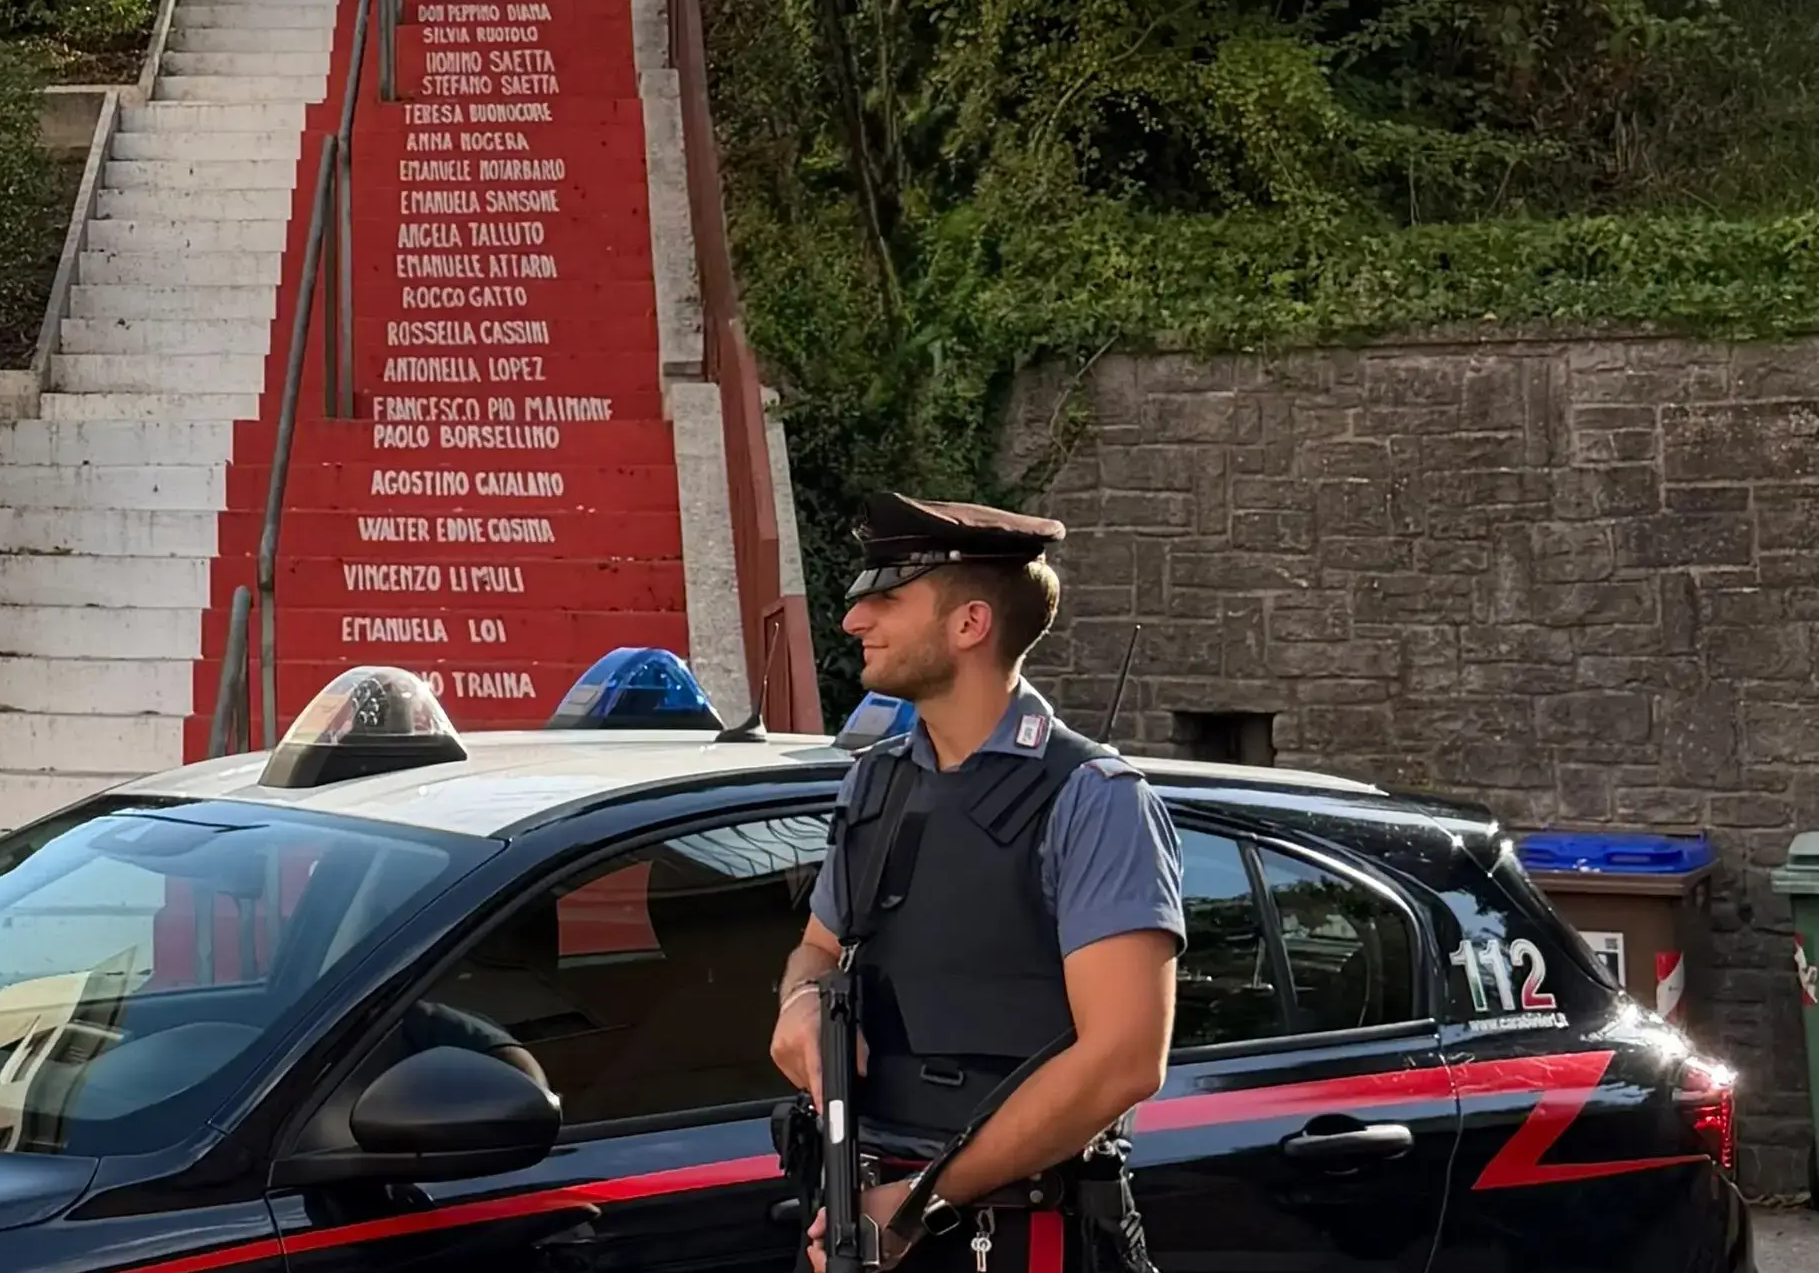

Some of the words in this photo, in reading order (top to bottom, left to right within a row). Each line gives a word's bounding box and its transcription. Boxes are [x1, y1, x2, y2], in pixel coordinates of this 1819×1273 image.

[418, 4, 445, 23] DON
[447, 4, 500, 22] PEPPINO
[507, 3, 552, 22] DIANA
[423, 27, 470, 44] SILVIA
[477, 26, 539, 44] RUOTOLO
[490, 49, 556, 73] SAETTA
[422, 75, 492, 97] STEFANO
[501, 75, 560, 96] SAETTA
[404, 104, 464, 125] TERESA
[406, 133, 453, 152] ANNA
[399, 160, 472, 182] EMANUELE
[400, 190, 481, 215] EMANUELA
[485, 189, 561, 213] SANSONE
[468, 222, 545, 247] TALLUTO
[396, 254, 485, 278] EMANUELE
[489, 254, 558, 279] ATTARDI
[402, 286, 465, 309] ROCCO
[468, 286, 528, 308] GATTO
[387, 321, 477, 347] ROSSELLA
[480, 320, 550, 345] CASSINI
[383, 357, 482, 383] ANTONELLA
[488, 356, 547, 381] LOPEZ
[373, 397, 480, 422] FRANCESCO
[488, 397, 516, 421] PIO
[525, 395, 613, 422] MAIMONE
[373, 424, 431, 449] PAOLO
[440, 424, 560, 449] BORSELLINO
[371, 470, 470, 496] AGOSTINO
[475, 471, 565, 498] CATALANO
[357, 517, 431, 543] WALTER
[436, 517, 486, 543] EDDIE
[487, 518, 556, 543] COSINA
[343, 564, 441, 592] VINCENZO
[448, 566, 468, 592] LI
[471, 566, 525, 593] MULI
[341, 617, 449, 644] EMANUELA
[468, 618, 507, 644] LOI
[451, 671, 537, 699] TRAINA
[1449, 938, 1557, 1012] 112
